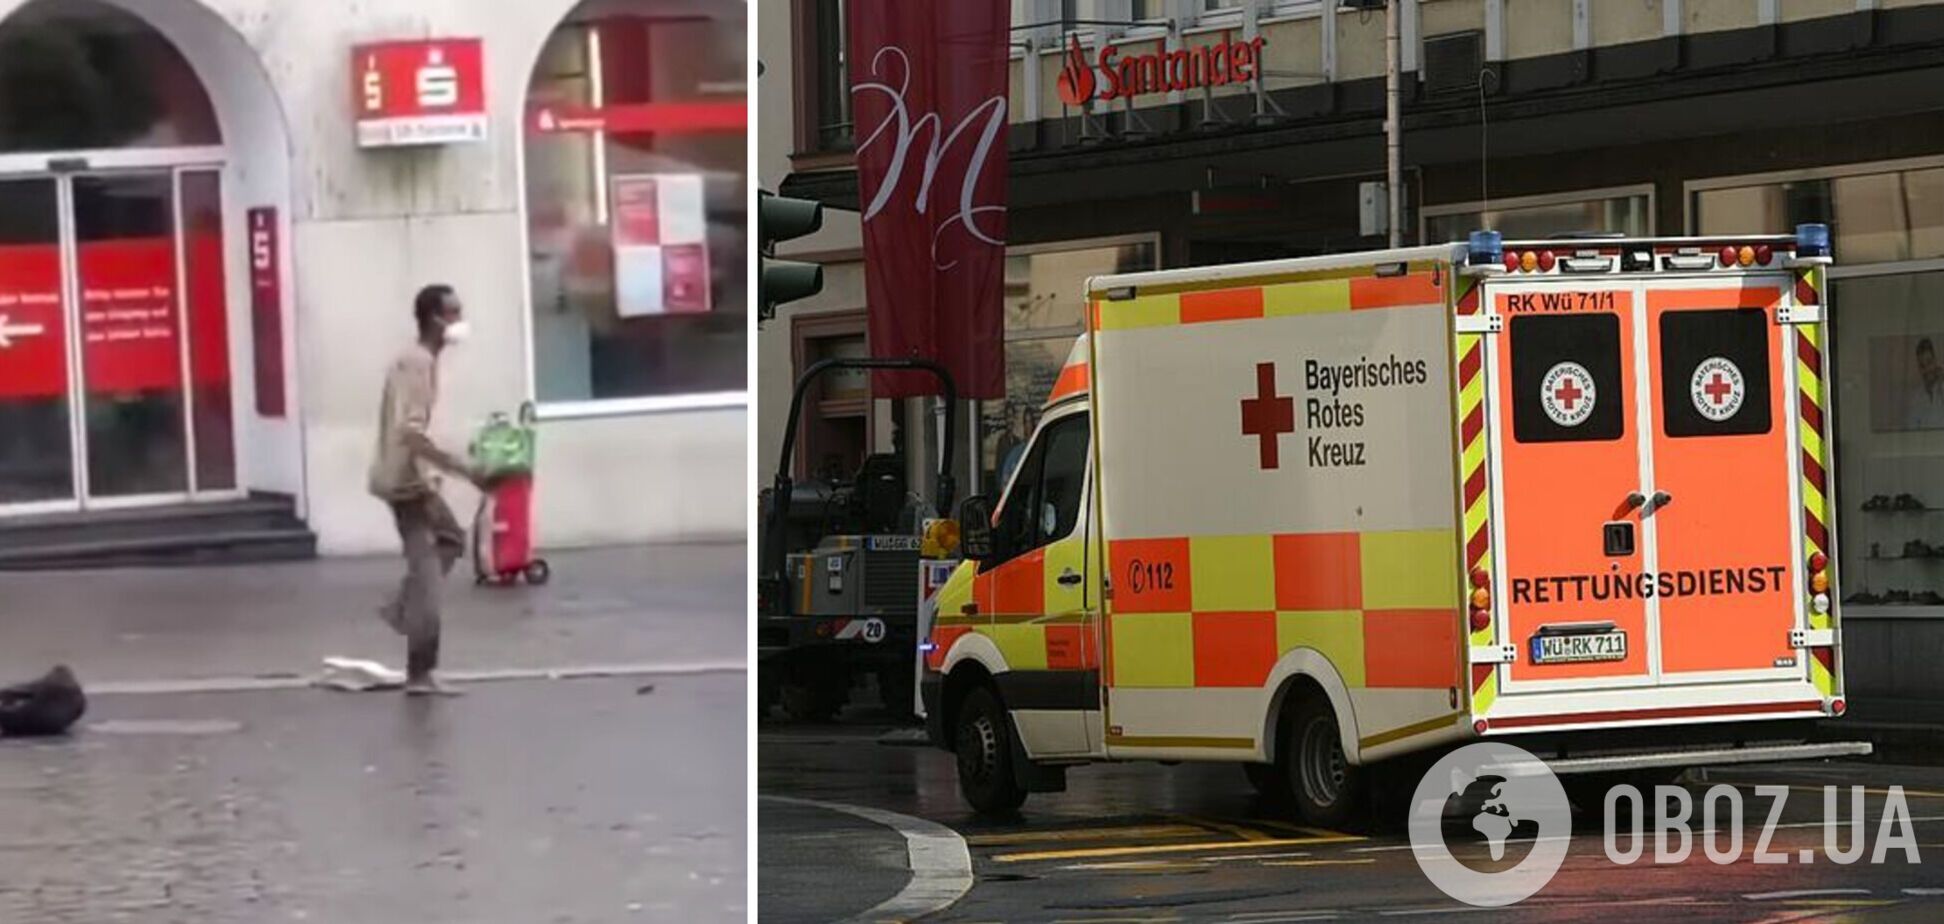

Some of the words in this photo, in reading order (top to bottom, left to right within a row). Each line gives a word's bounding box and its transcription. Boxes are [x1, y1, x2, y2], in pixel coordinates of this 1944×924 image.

[1100, 29, 1267, 100] Santander
[851, 46, 1007, 270] M
[1507, 293, 1536, 312] RK
[1541, 292, 1573, 311] Wü
[1578, 291, 1615, 310] 71/1
[1305, 354, 1427, 396] Bayerisches
[1545, 366, 1591, 392] BAYERISCHES
[1695, 362, 1740, 387] BAYERISCHES
[1306, 397, 1364, 429] Rotes
[1308, 435, 1366, 467] Kreuz
[1146, 562, 1173, 590] 112
[1512, 567, 1786, 604] RETTUNGSDIENST
[866, 622, 882, 638] 20
[1572, 637, 1593, 655] RK
[1595, 635, 1624, 654] 711
